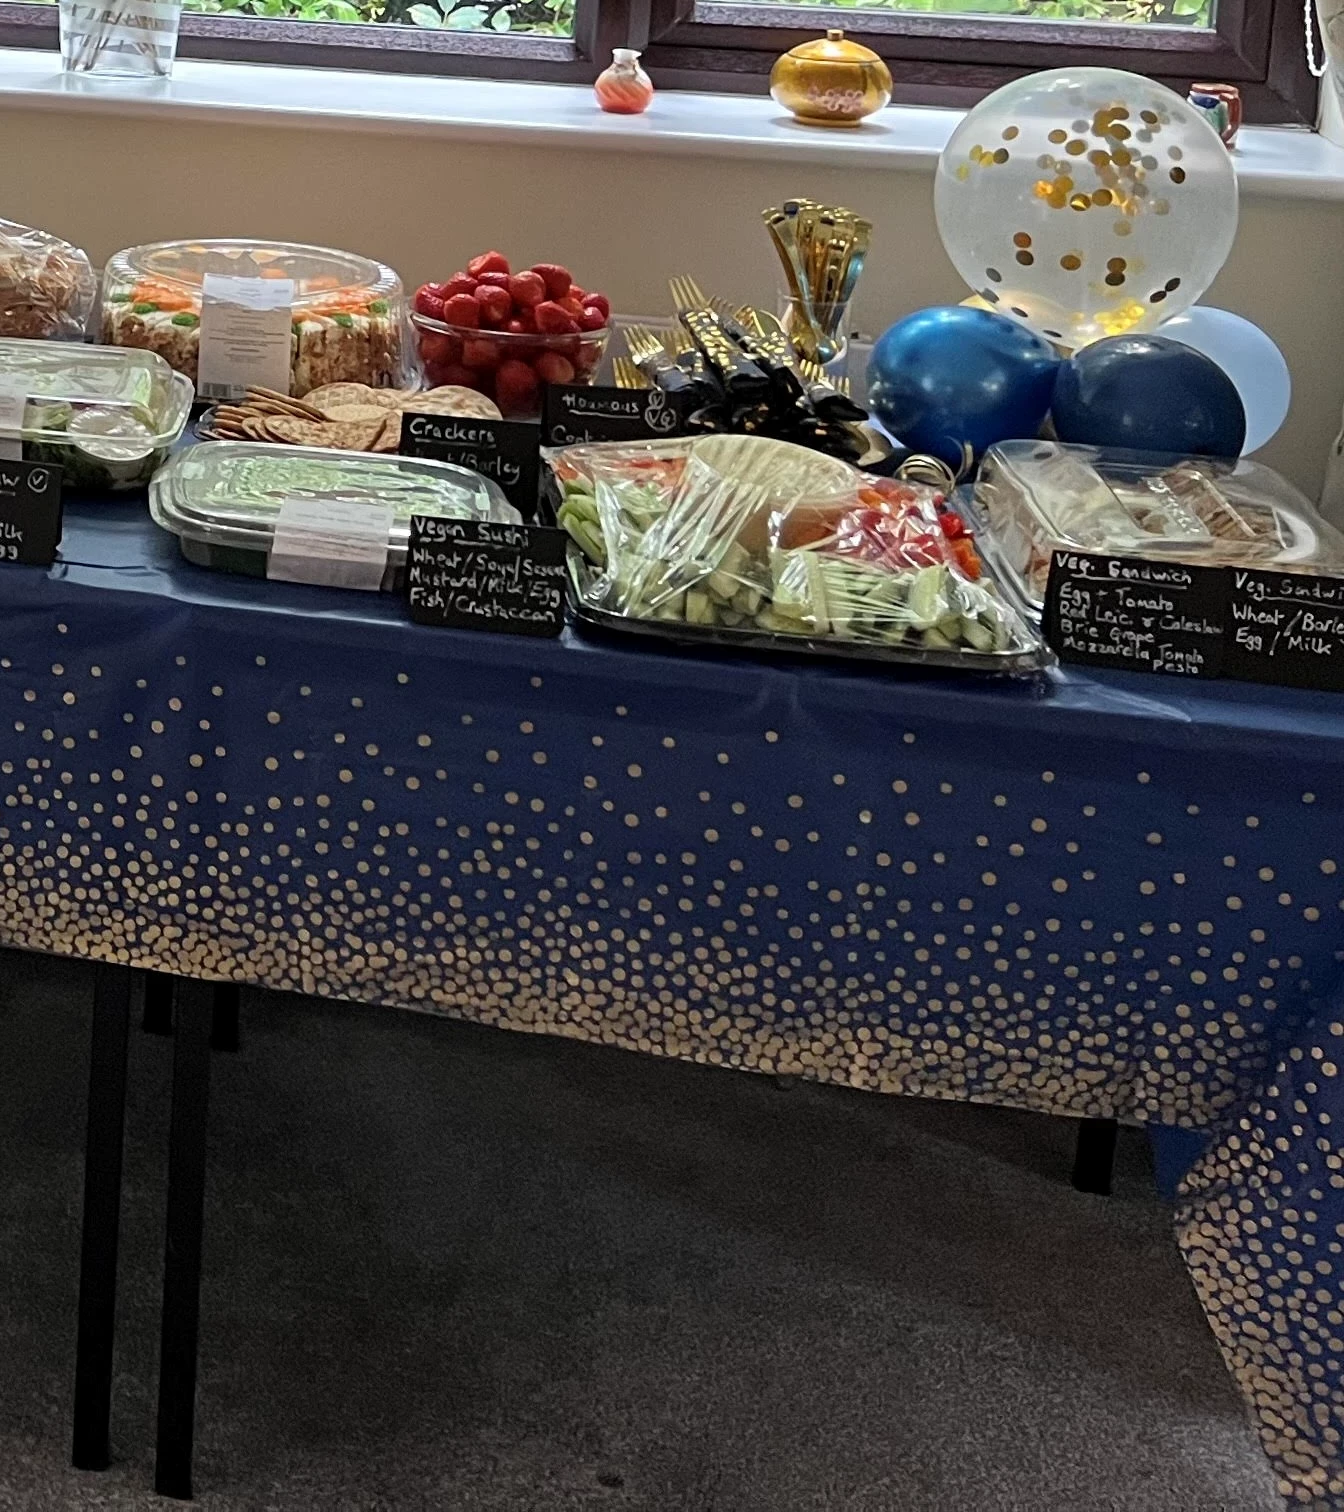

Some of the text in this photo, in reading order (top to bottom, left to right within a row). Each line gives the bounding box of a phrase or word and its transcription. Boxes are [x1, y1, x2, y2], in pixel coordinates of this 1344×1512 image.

[409, 417, 496, 442] Crackers
[413, 516, 529, 547] Vegan Sushi
[1056, 552, 1192, 584] Veg. Sandwich
[1059, 581, 1091, 609] Egg
[1115, 586, 1174, 611] Tomato
[1235, 571, 1344, 601] Veg. Sandwi
[1059, 600, 1087, 619] Red
[1095, 605, 1134, 626] Leic.
[1159, 614, 1224, 635] Coleslaw
[1061, 618, 1155, 649] Brie Grape
[1235, 625, 1263, 651] Egg
[1287, 635, 1332, 656] Milk
[1153, 659, 1199, 675] Pesto
[1157, 643, 1204, 664] Tomato
